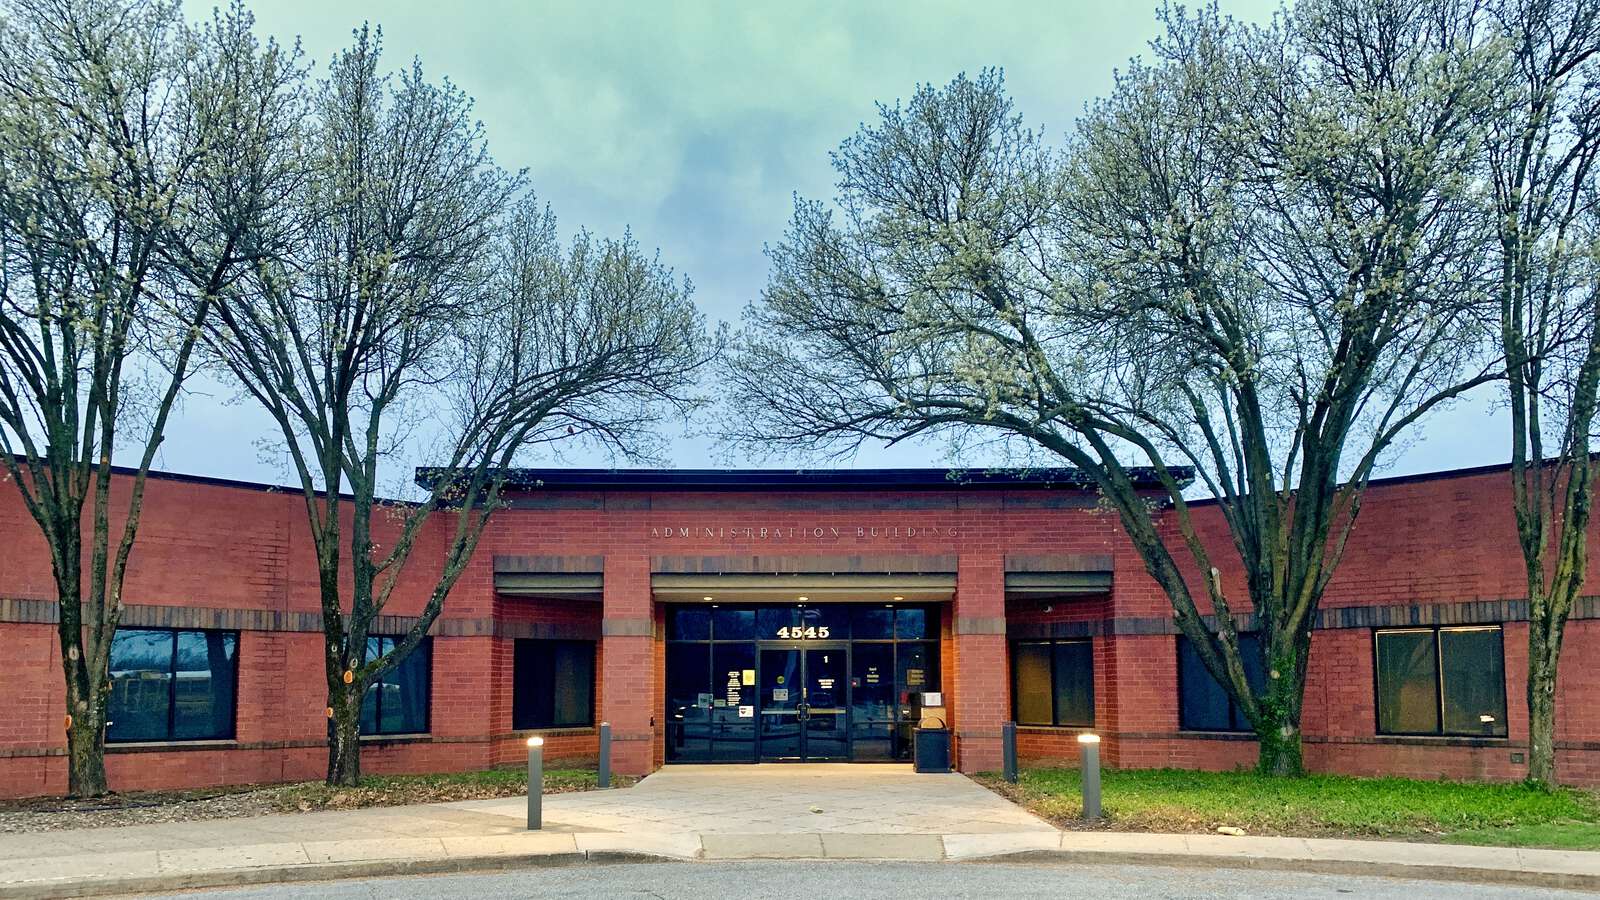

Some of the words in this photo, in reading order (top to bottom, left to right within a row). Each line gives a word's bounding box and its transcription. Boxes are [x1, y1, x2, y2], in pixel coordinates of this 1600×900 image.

[651, 527, 839, 538] ADMINISTRATION
[857, 527, 958, 538] BUILDING
[776, 626, 829, 638] 4545
[823, 655, 828, 664] 1
